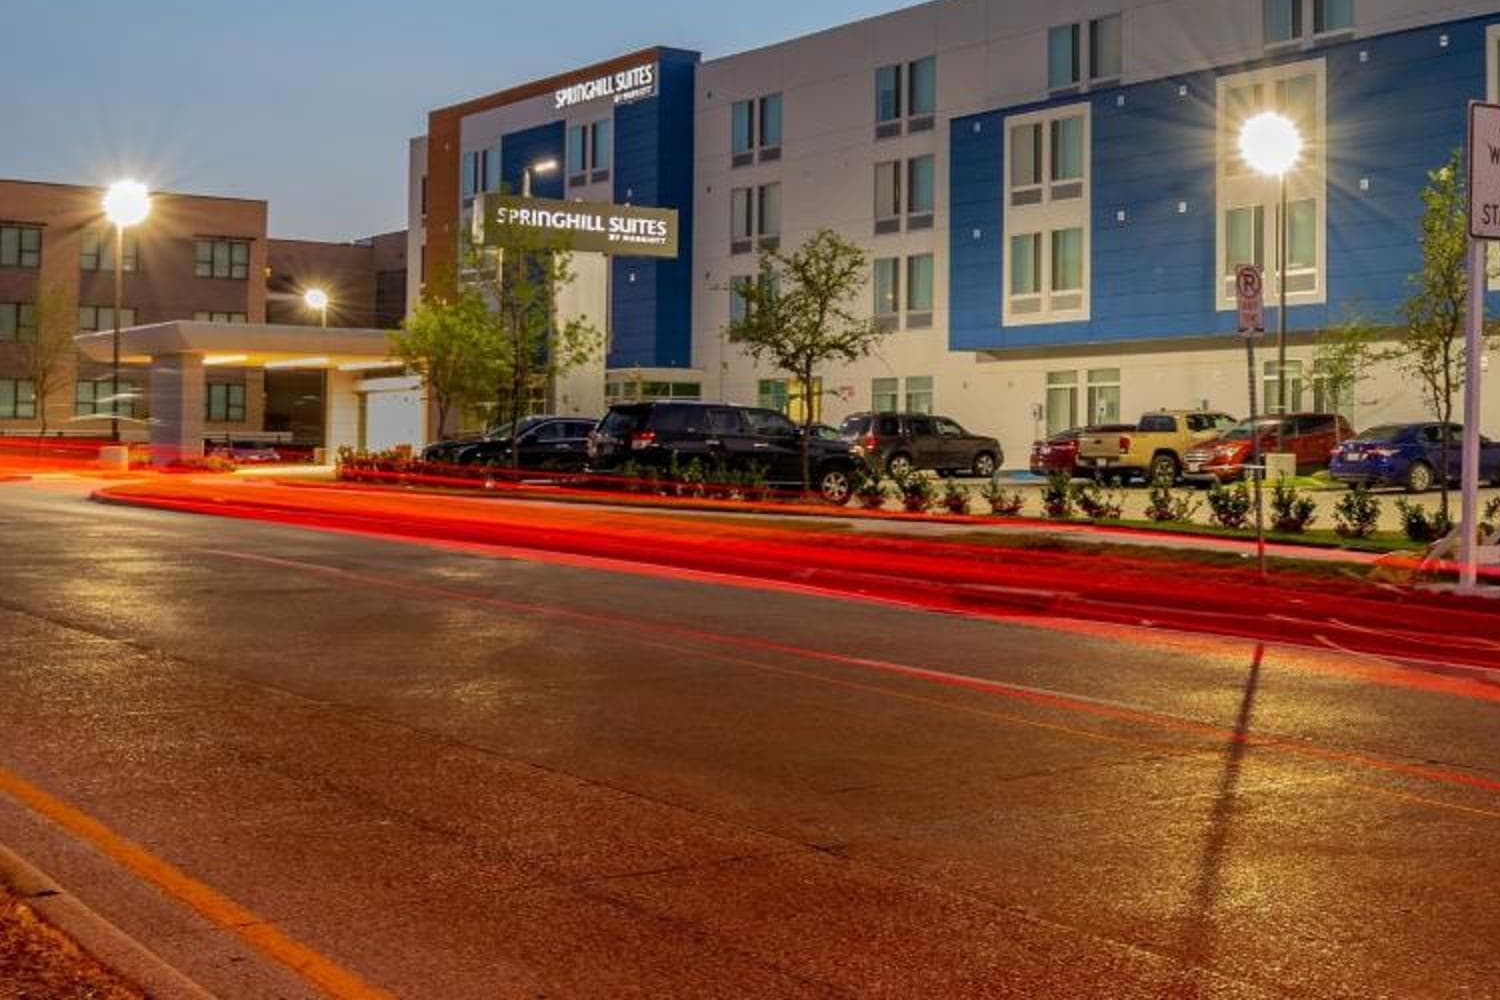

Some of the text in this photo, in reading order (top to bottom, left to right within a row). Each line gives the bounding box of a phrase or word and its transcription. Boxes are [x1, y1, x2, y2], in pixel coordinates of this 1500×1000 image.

[615, 64, 652, 91] SUITES
[496, 207, 667, 236] SPRINGHILL SUITES
